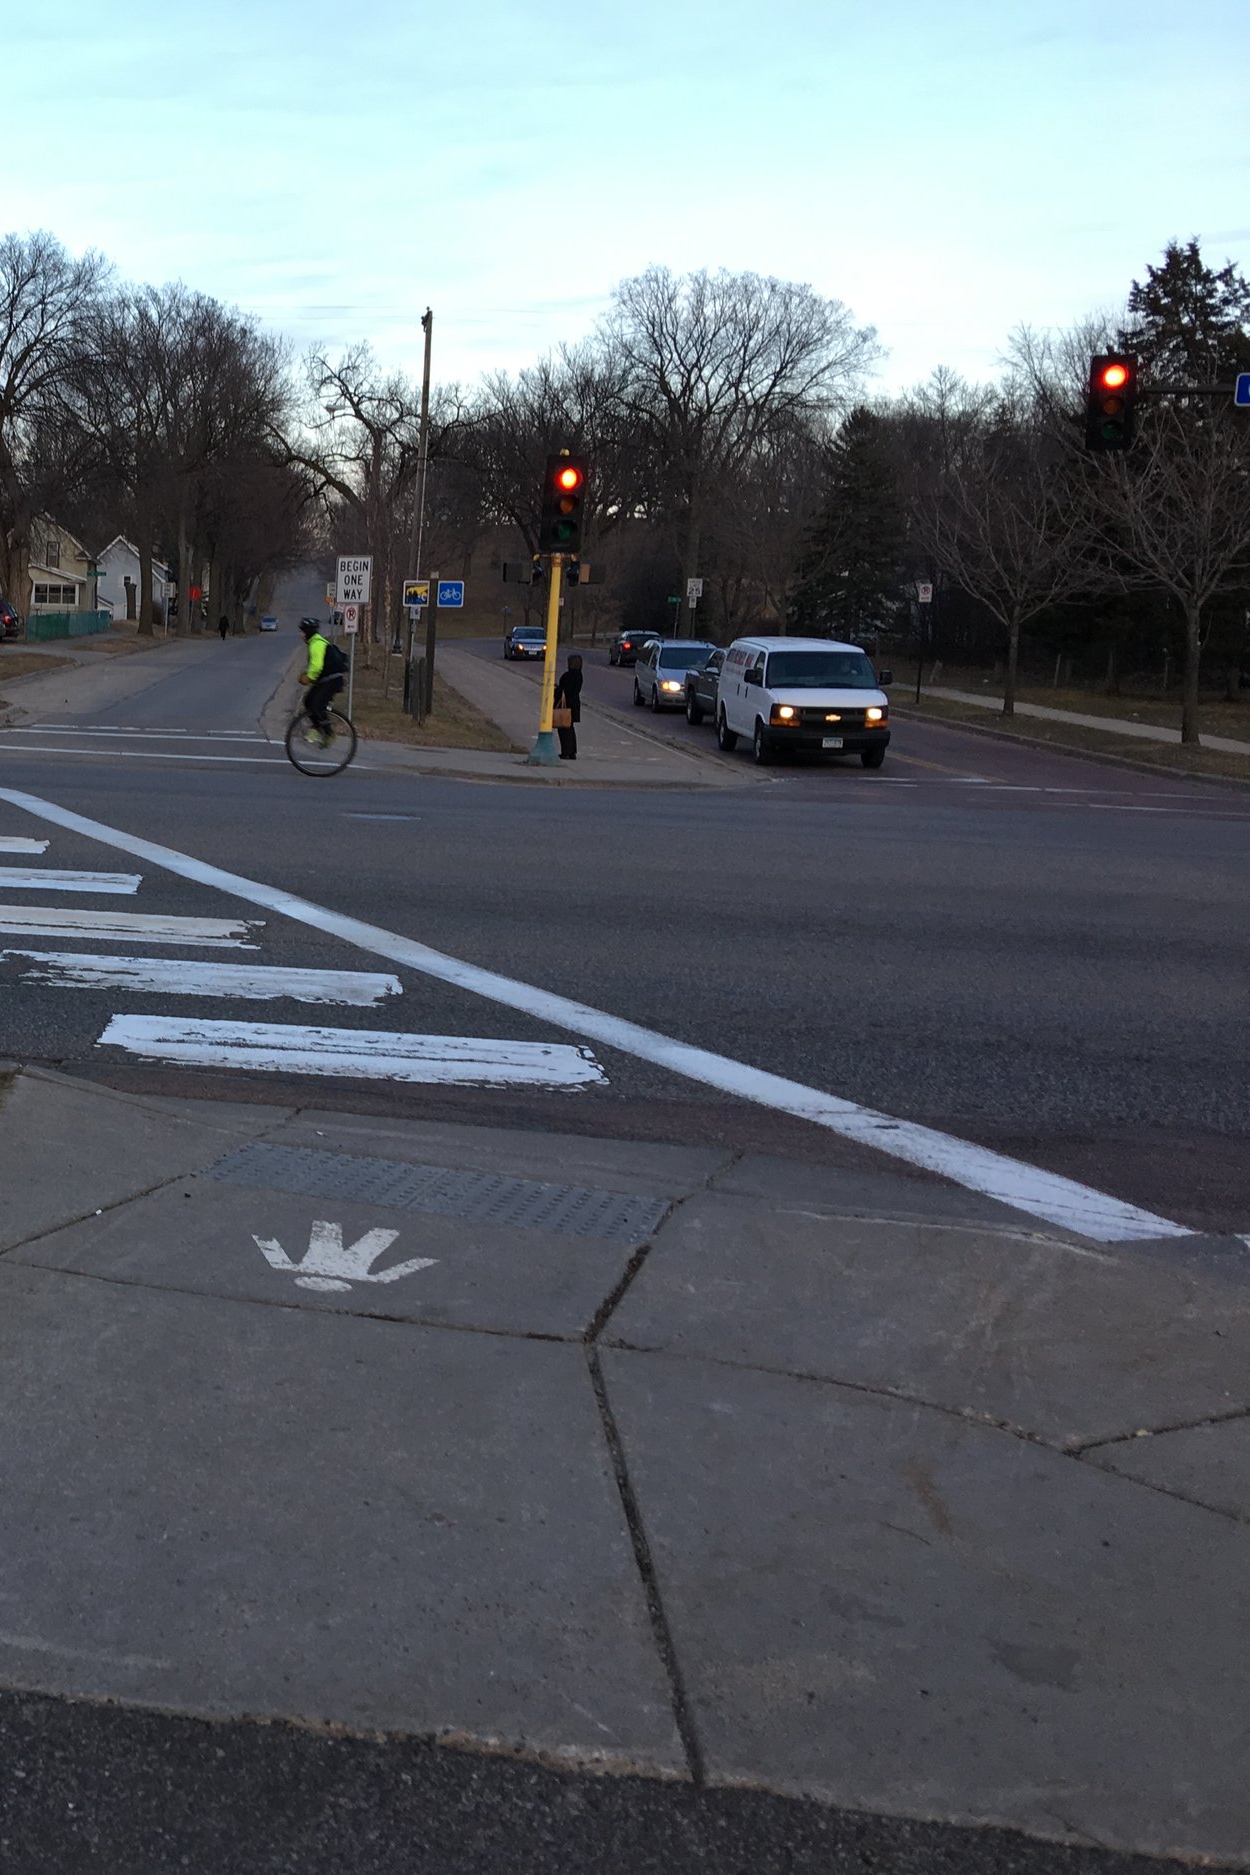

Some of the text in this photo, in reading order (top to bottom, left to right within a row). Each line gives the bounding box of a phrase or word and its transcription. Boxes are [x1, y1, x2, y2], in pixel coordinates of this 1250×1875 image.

[340, 560, 369, 572] BEGIN
[343, 574, 363, 586] ONE
[343, 589, 363, 600] WAY
